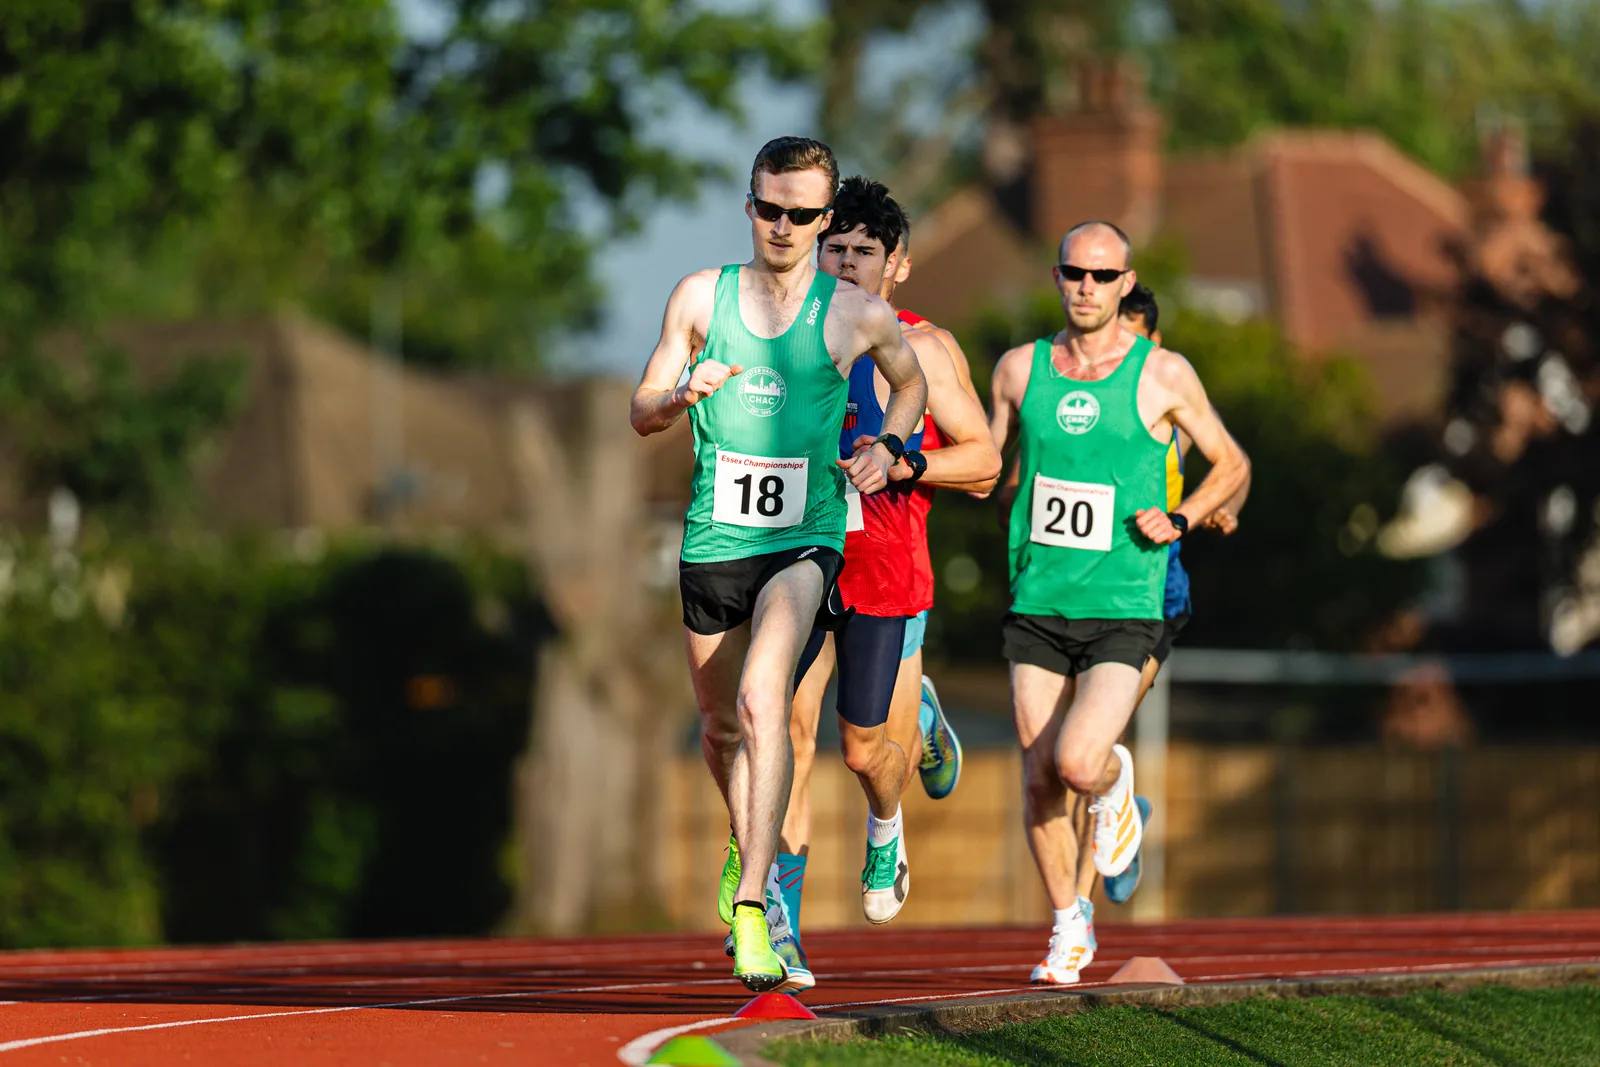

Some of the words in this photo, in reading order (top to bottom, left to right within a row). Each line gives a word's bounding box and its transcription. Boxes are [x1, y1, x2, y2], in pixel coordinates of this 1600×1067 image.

[807, 297, 822, 326] soar
[749, 396, 775, 405] CHAC
[721, 455, 742, 465] Essex
[743, 458, 804, 470] Championships
[733, 473, 784, 517] 18
[1044, 496, 1093, 538] 20
